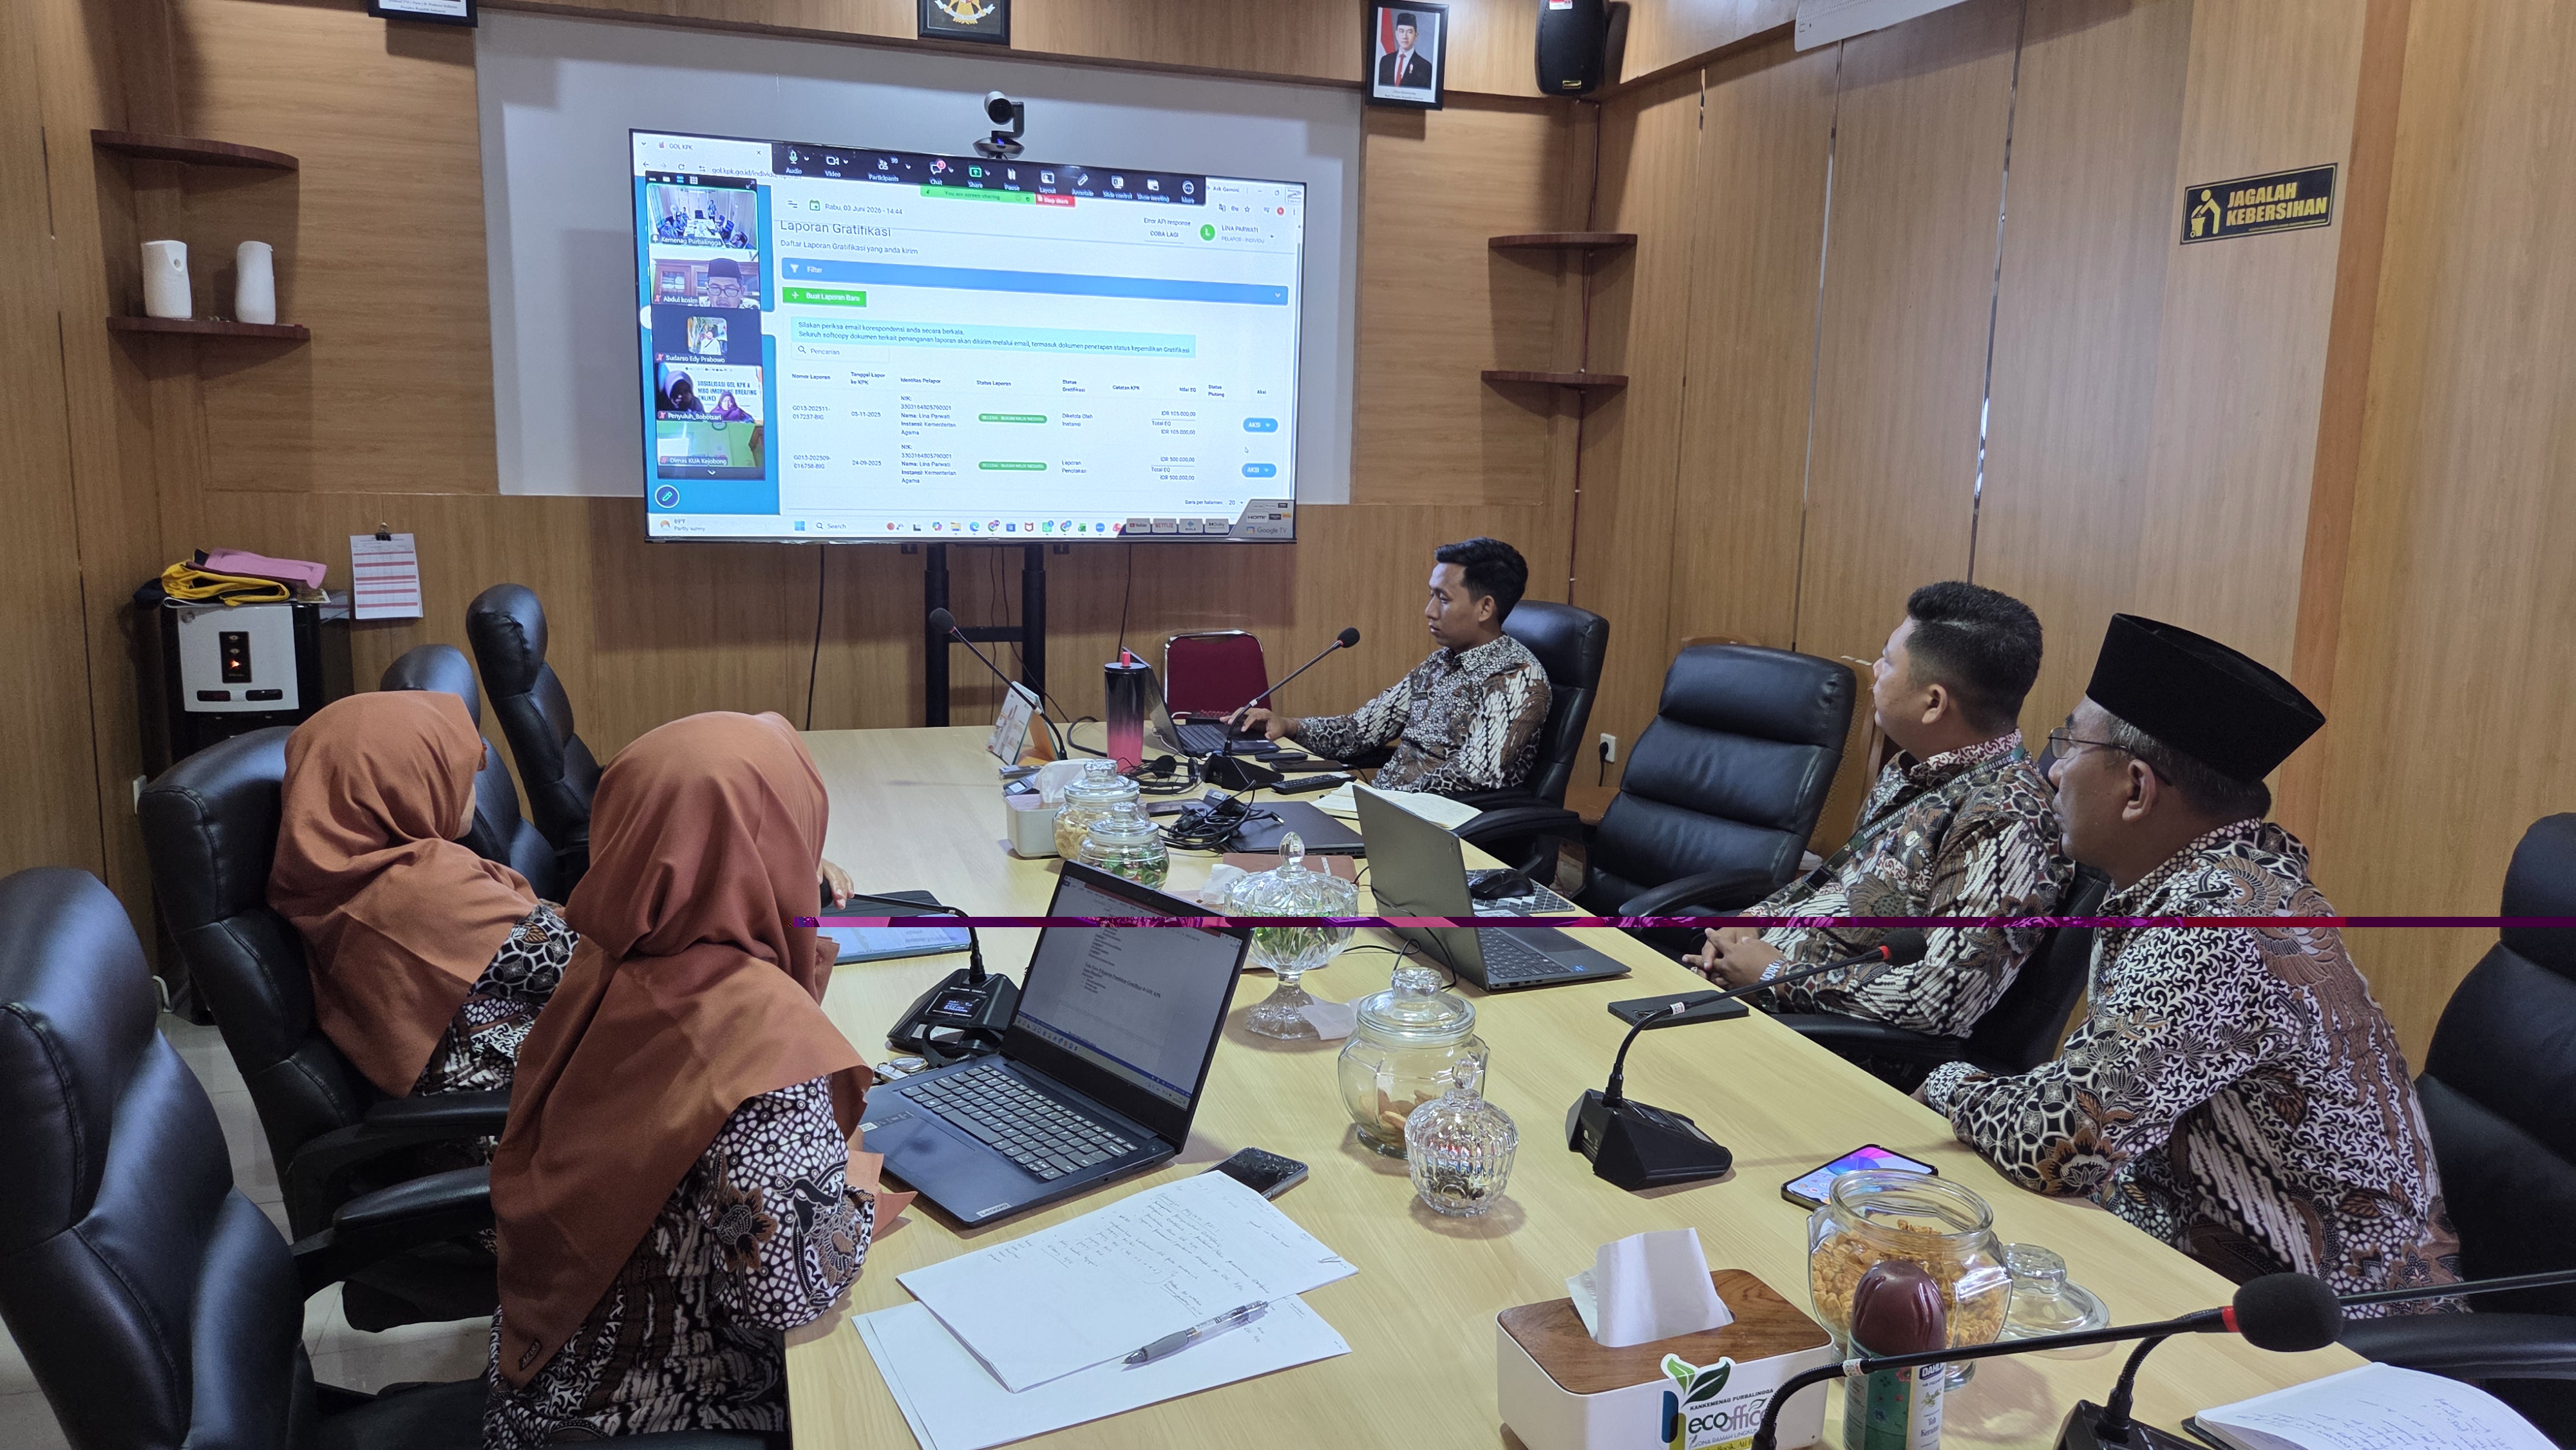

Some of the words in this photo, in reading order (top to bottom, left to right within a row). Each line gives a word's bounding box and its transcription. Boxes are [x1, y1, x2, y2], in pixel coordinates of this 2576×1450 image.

[869, 174, 899, 182] Participants
[1004, 183, 1020, 191] Pause
[1039, 186, 1056, 194] Layout
[1072, 188, 1094, 197] Annotate
[2227, 182, 2298, 209] JAGALAH
[2226, 196, 2327, 227] KEBERSIHAN
[780, 220, 829, 233] Laporan
[833, 223, 891, 237] Gratifikasi
[661, 236, 687, 245] Kemenag
[688, 238, 722, 247] Purbalingga
[804, 241, 831, 250] Laporan
[867, 245, 883, 254] yang
[862, 325, 905, 334] korespondensi
[898, 335, 934, 343] penanganan
[1084, 343, 1113, 352] penetapan
[1257, 526, 1278, 535] Google
[980, 1204, 1008, 1216] Lenovo
[1690, 1398, 1731, 1411] KANKEMENAG
[1732, 1388, 1774, 1402] PURBALINGGA
[1688, 1404, 1766, 1435] ecooffic
[1712, 1434, 1733, 1443] RAMAH
